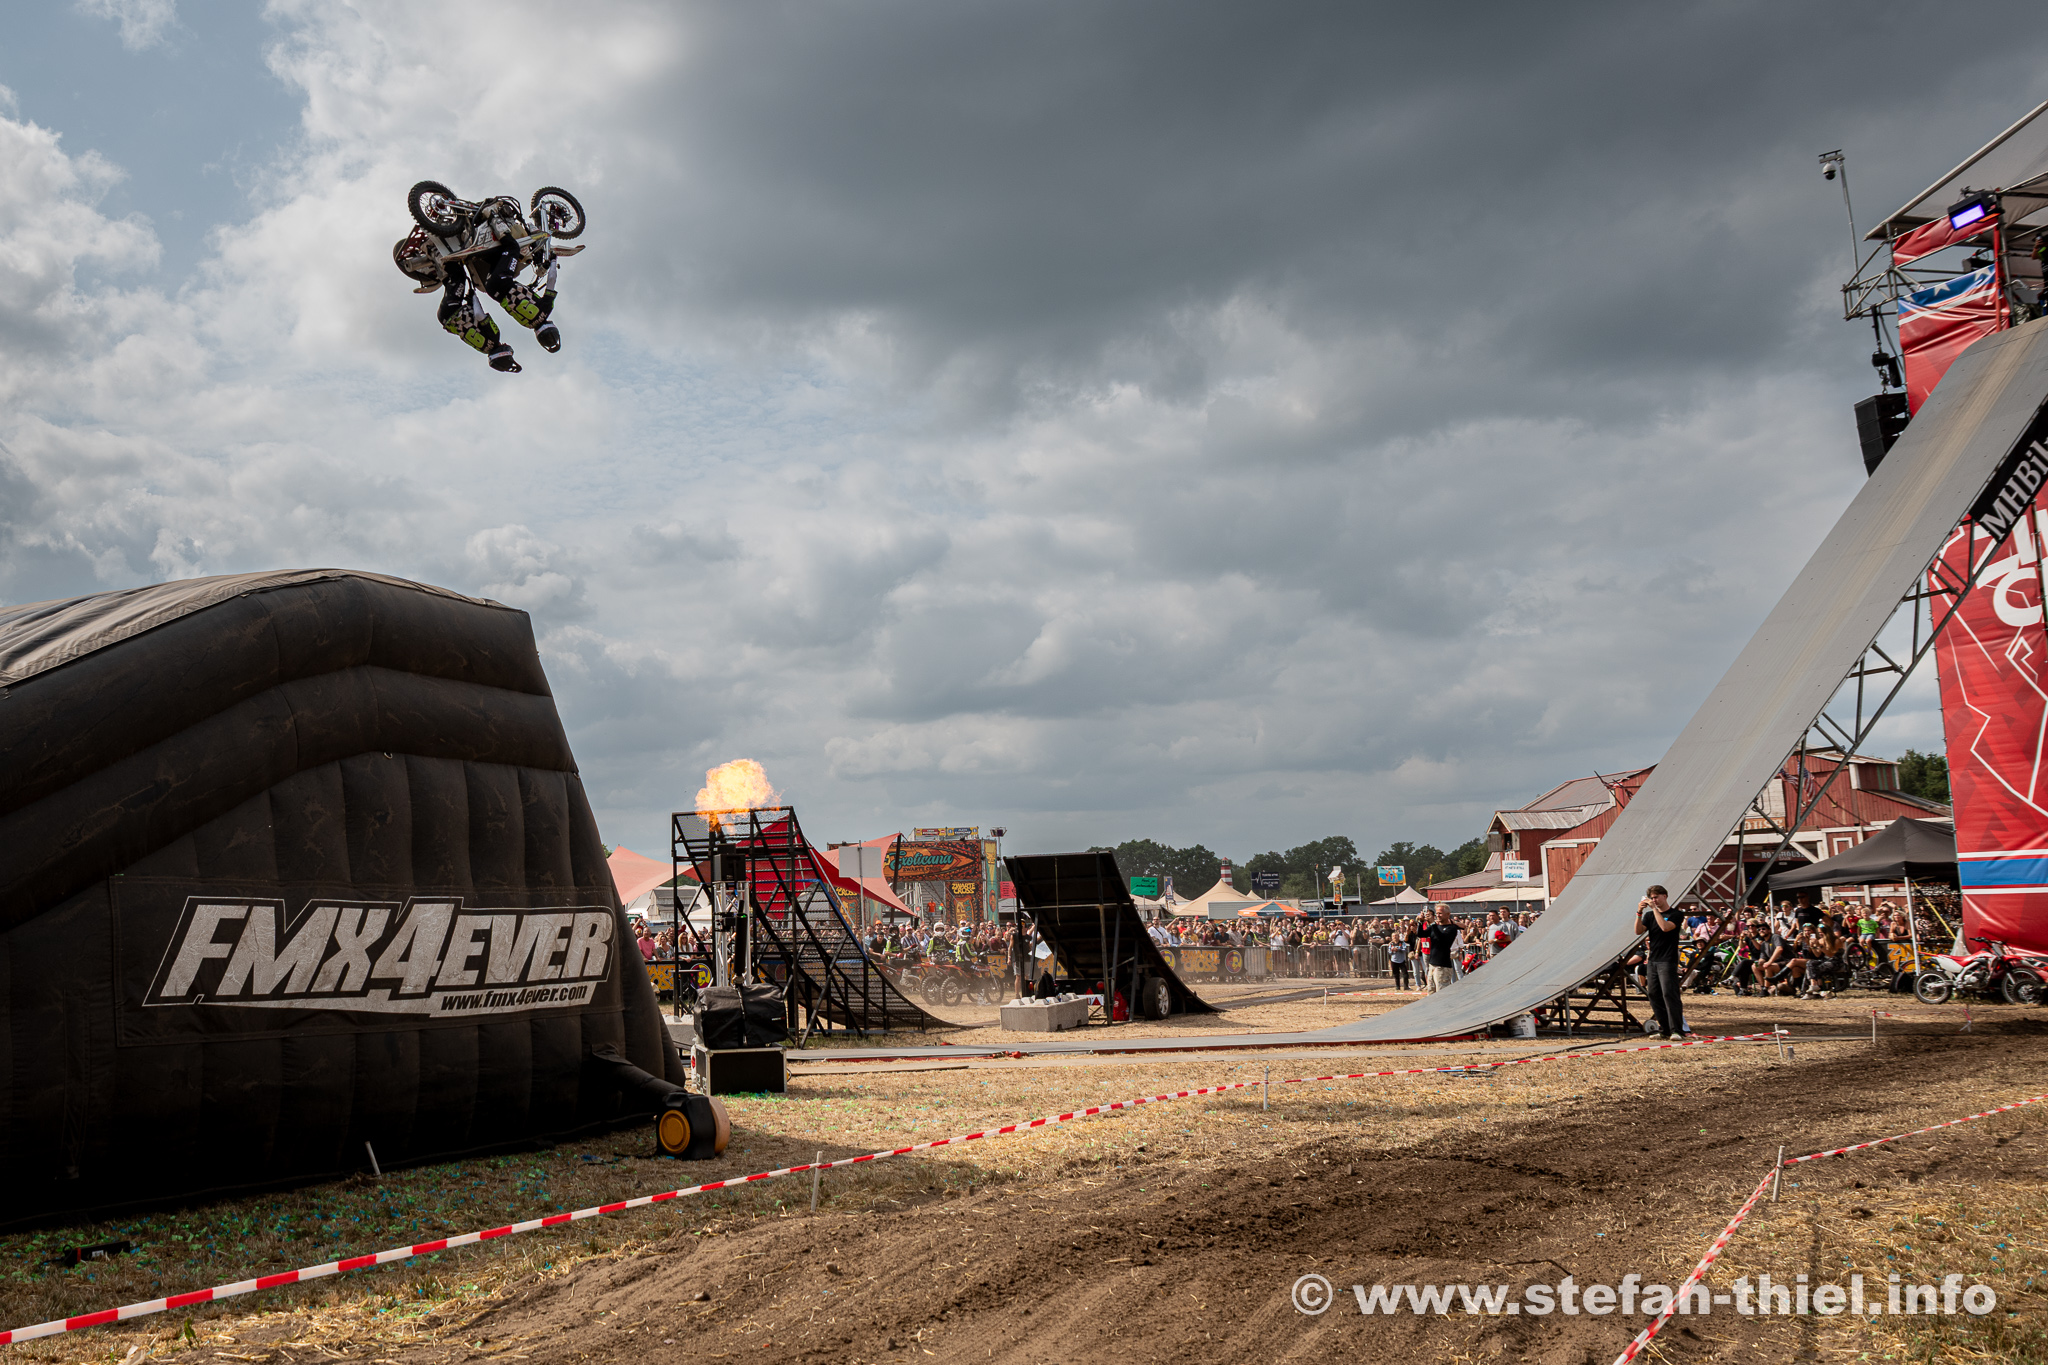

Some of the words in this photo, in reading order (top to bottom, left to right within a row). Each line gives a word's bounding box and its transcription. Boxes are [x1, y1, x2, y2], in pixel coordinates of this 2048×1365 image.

[1980, 437, 2048, 541] MHBil
[160, 902, 613, 997] FMX4EVER
[1180, 949, 1221, 965] ZWARTE
[1183, 960, 1218, 973] CROSS
[441, 983, 588, 1011] www.fmx4ever.com
